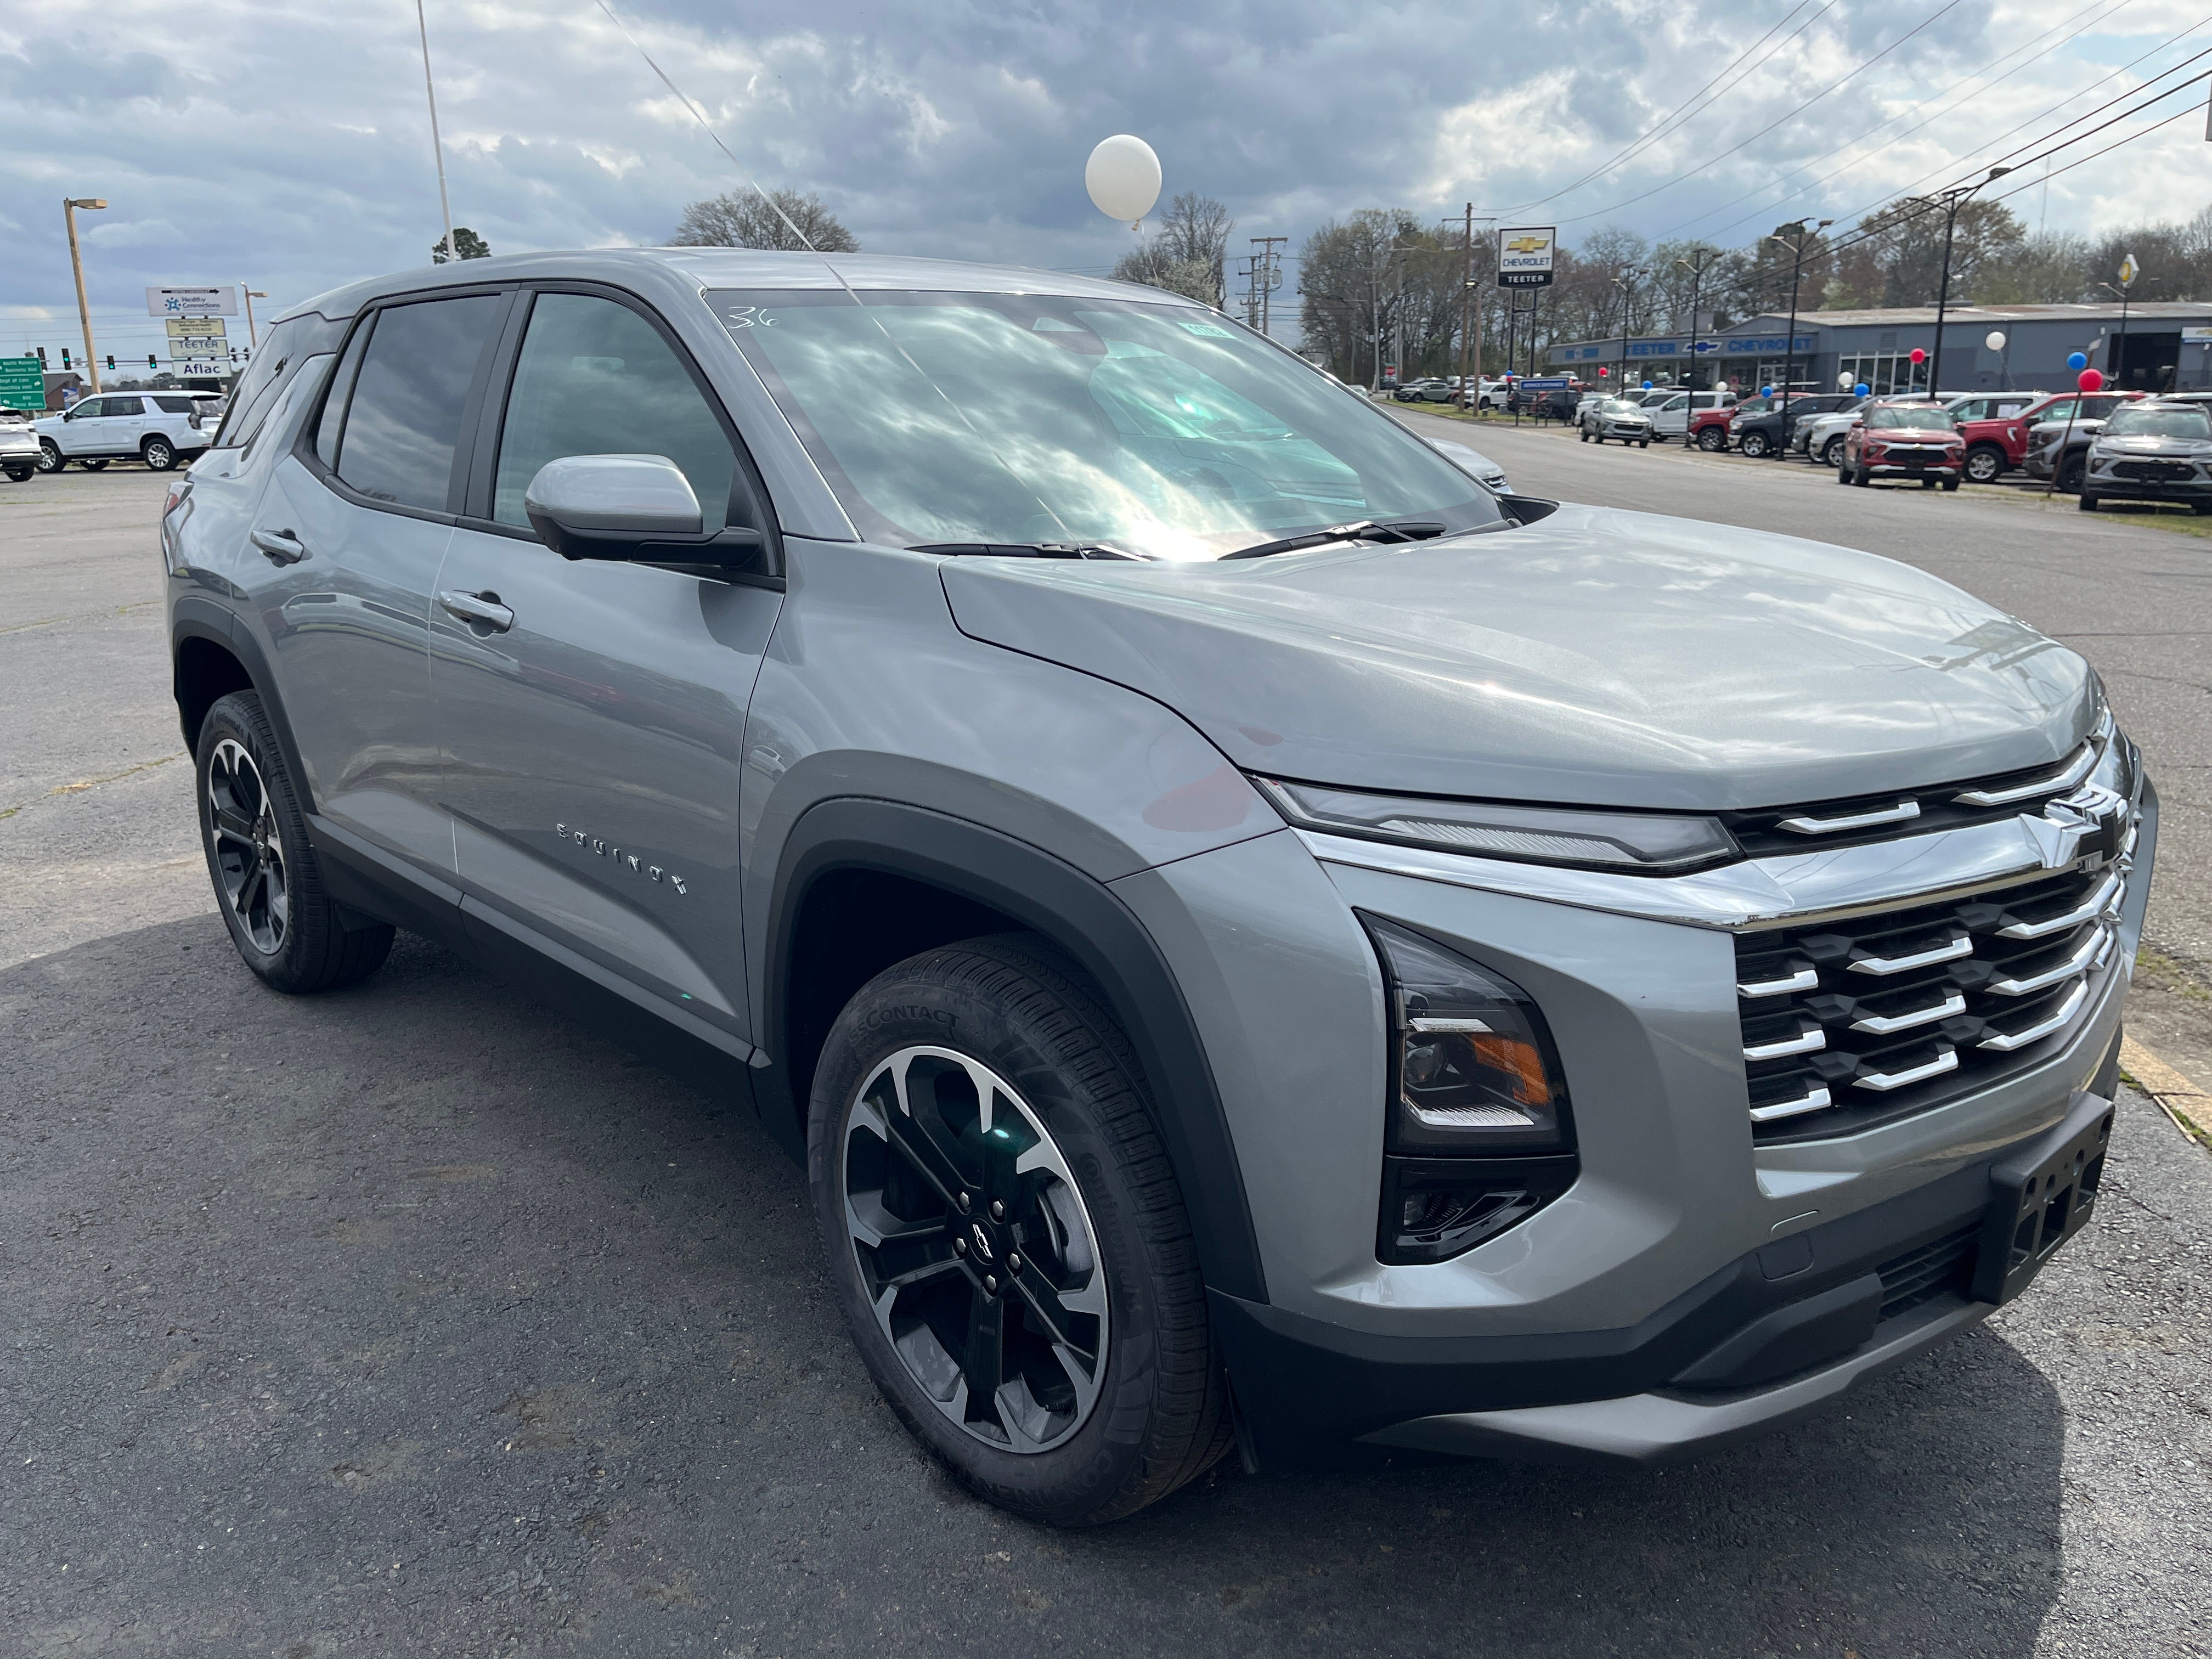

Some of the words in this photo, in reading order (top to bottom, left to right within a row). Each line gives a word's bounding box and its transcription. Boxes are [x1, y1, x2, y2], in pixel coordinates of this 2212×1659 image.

[1503, 257, 1550, 267] CHEVROLET
[1508, 275, 1544, 283] TEETER
[726, 306, 780, 329] 36
[184, 364, 221, 374] Aflac
[556, 822, 687, 895] EQUINOX
